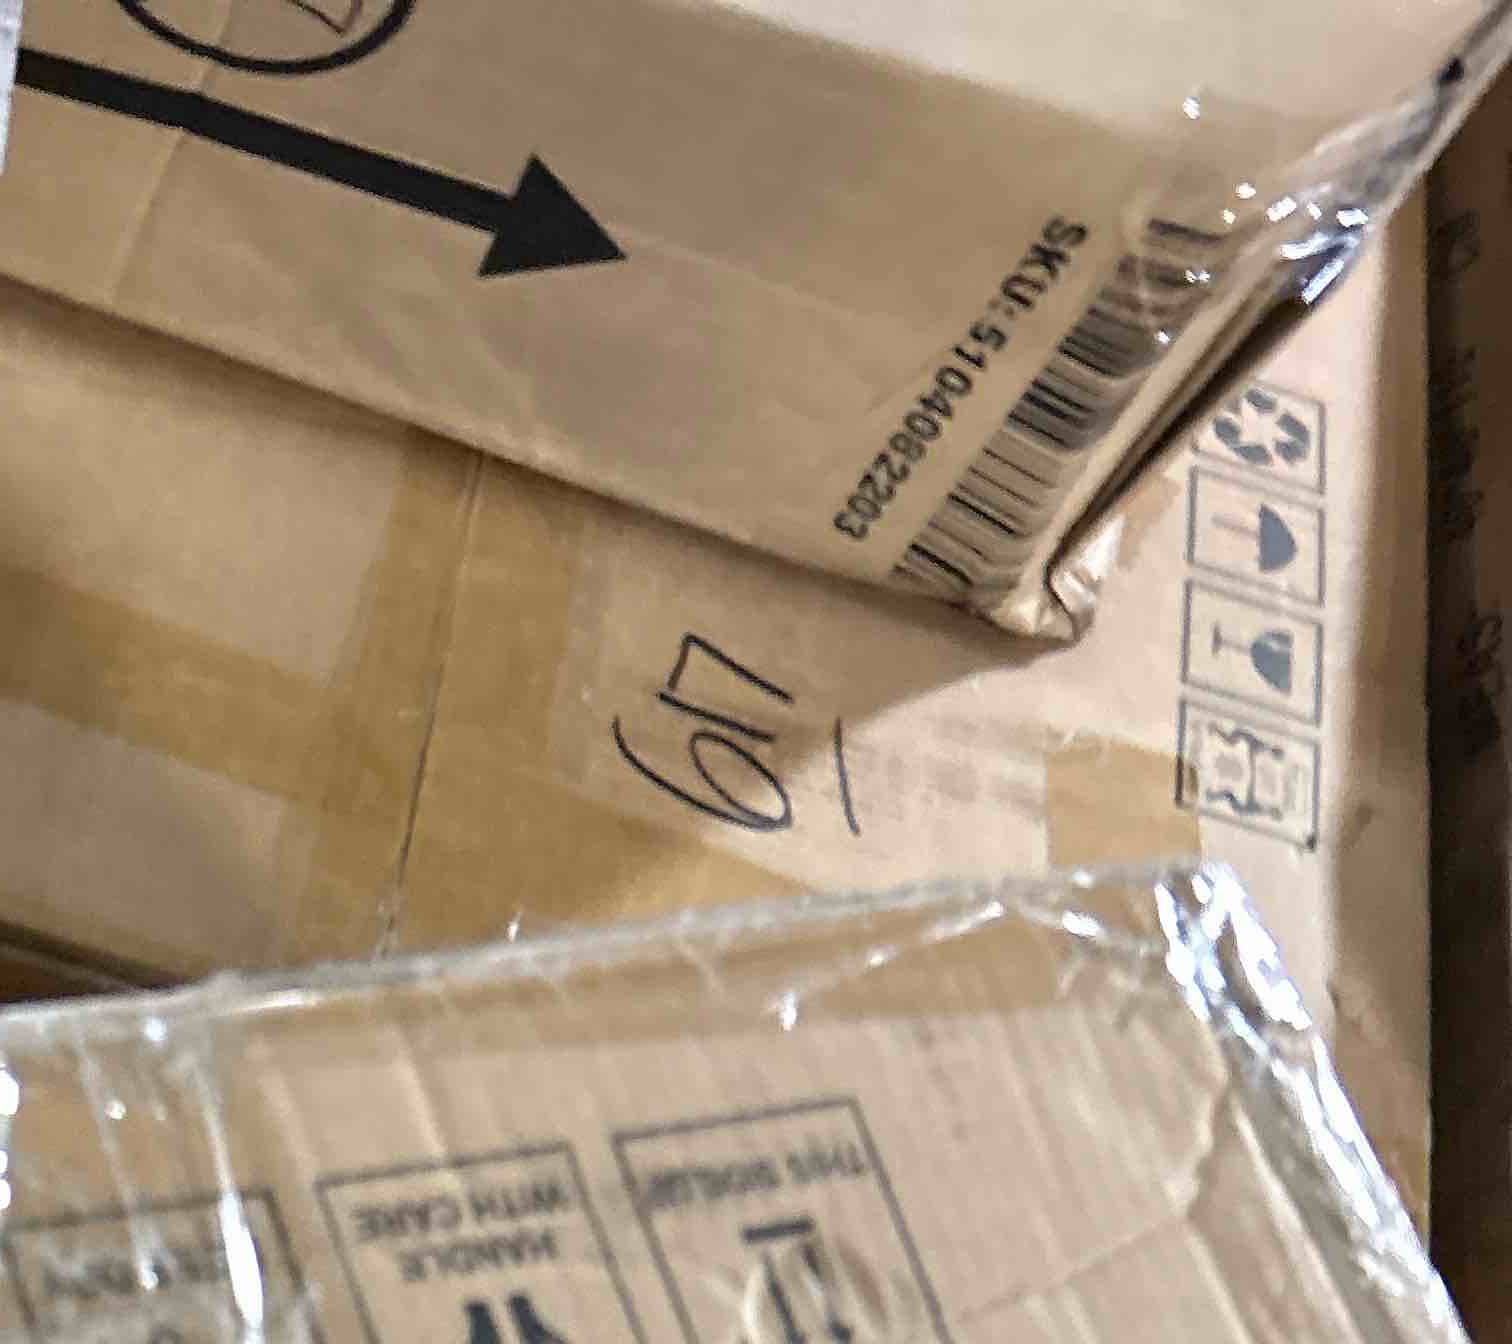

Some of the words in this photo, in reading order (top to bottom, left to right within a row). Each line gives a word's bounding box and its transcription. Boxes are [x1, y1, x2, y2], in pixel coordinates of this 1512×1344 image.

[355, 1194, 463, 1243] CARE
[472, 1181, 570, 1220] WITH
[401, 1228, 558, 1281] HANDLE
